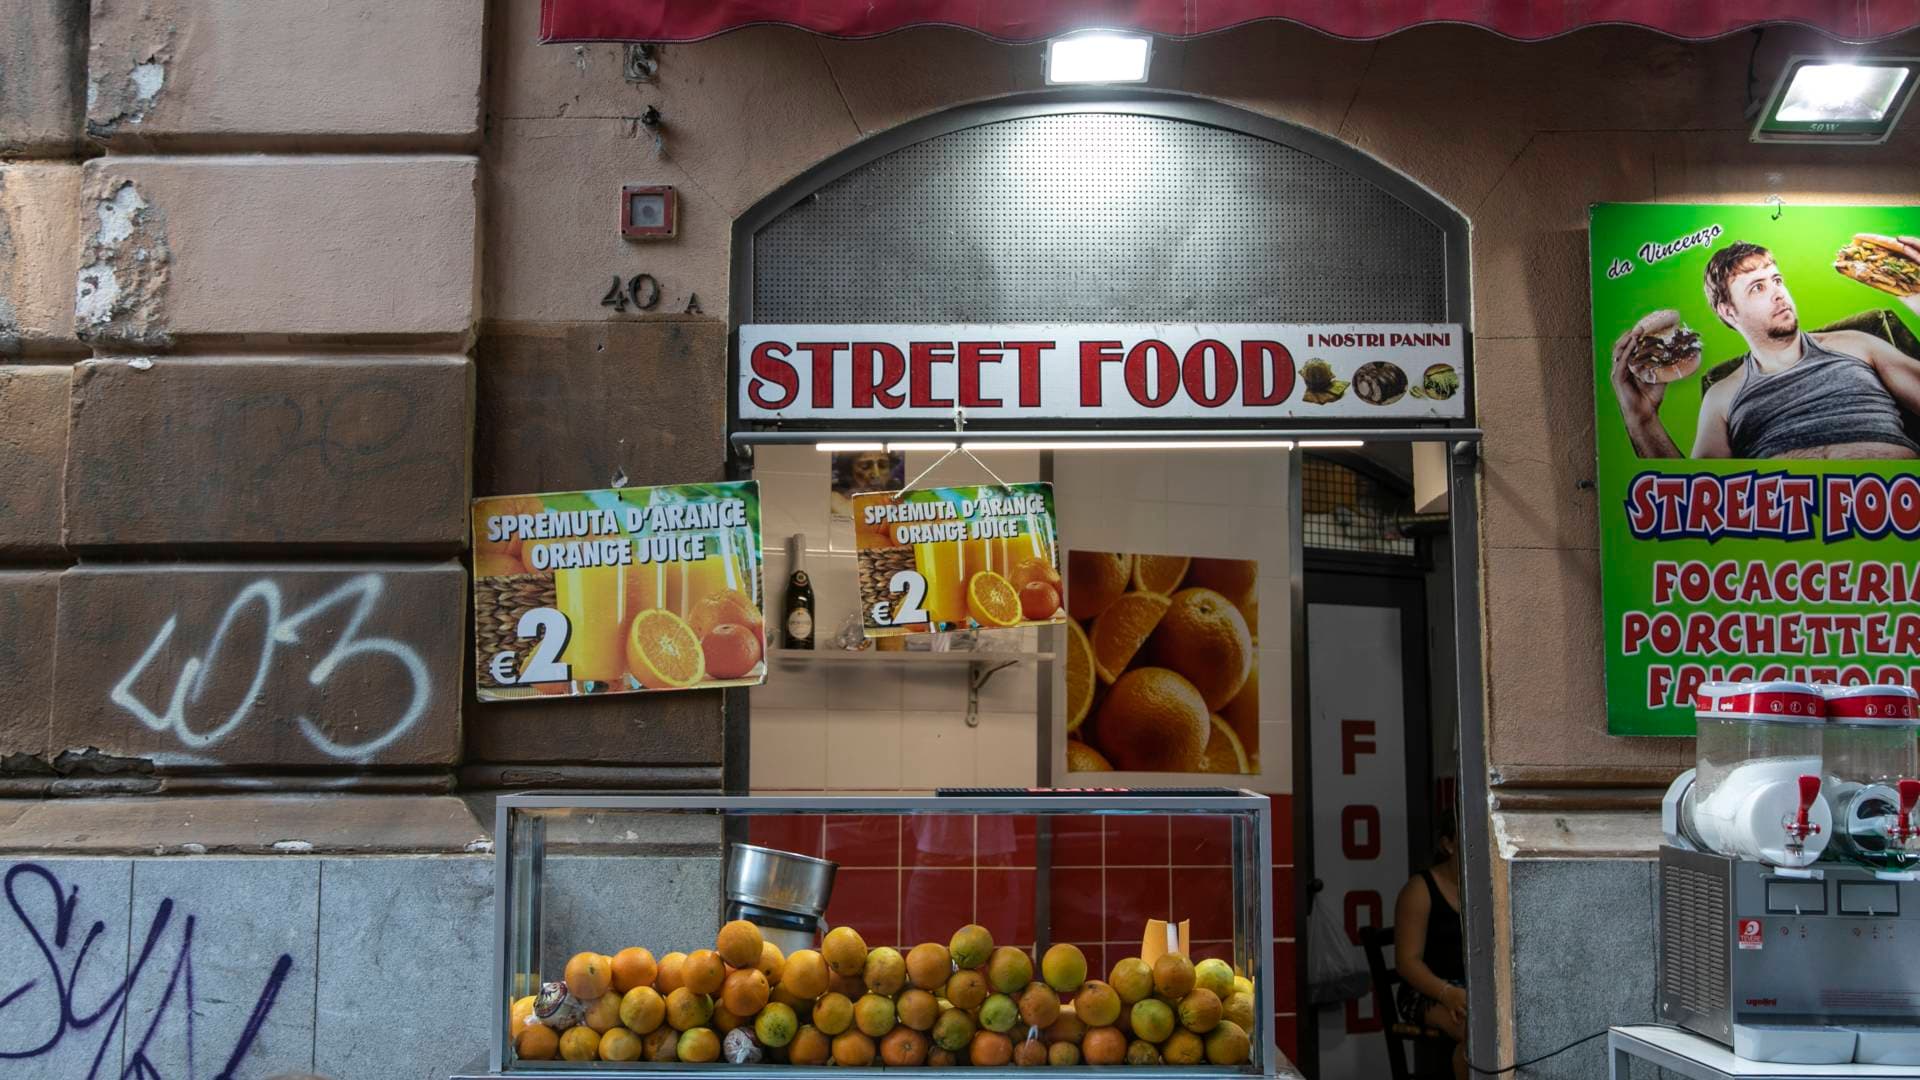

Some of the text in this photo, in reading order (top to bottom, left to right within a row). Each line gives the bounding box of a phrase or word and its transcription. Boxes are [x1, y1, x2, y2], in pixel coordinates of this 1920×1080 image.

[1607, 224, 1723, 278] da Vincenzo
[601, 273, 703, 314] 40 A
[1308, 333, 1450, 347] I NOSTRI PANINI
[749, 340, 1294, 410] STREET FOOD
[865, 502, 957, 525] SPREMUTA
[1628, 473, 1814, 535] STREET
[487, 509, 619, 542] SPREMUTA
[896, 519, 1018, 545] ORANGE JUICE
[530, 534, 706, 570] ORANGE JUICE
